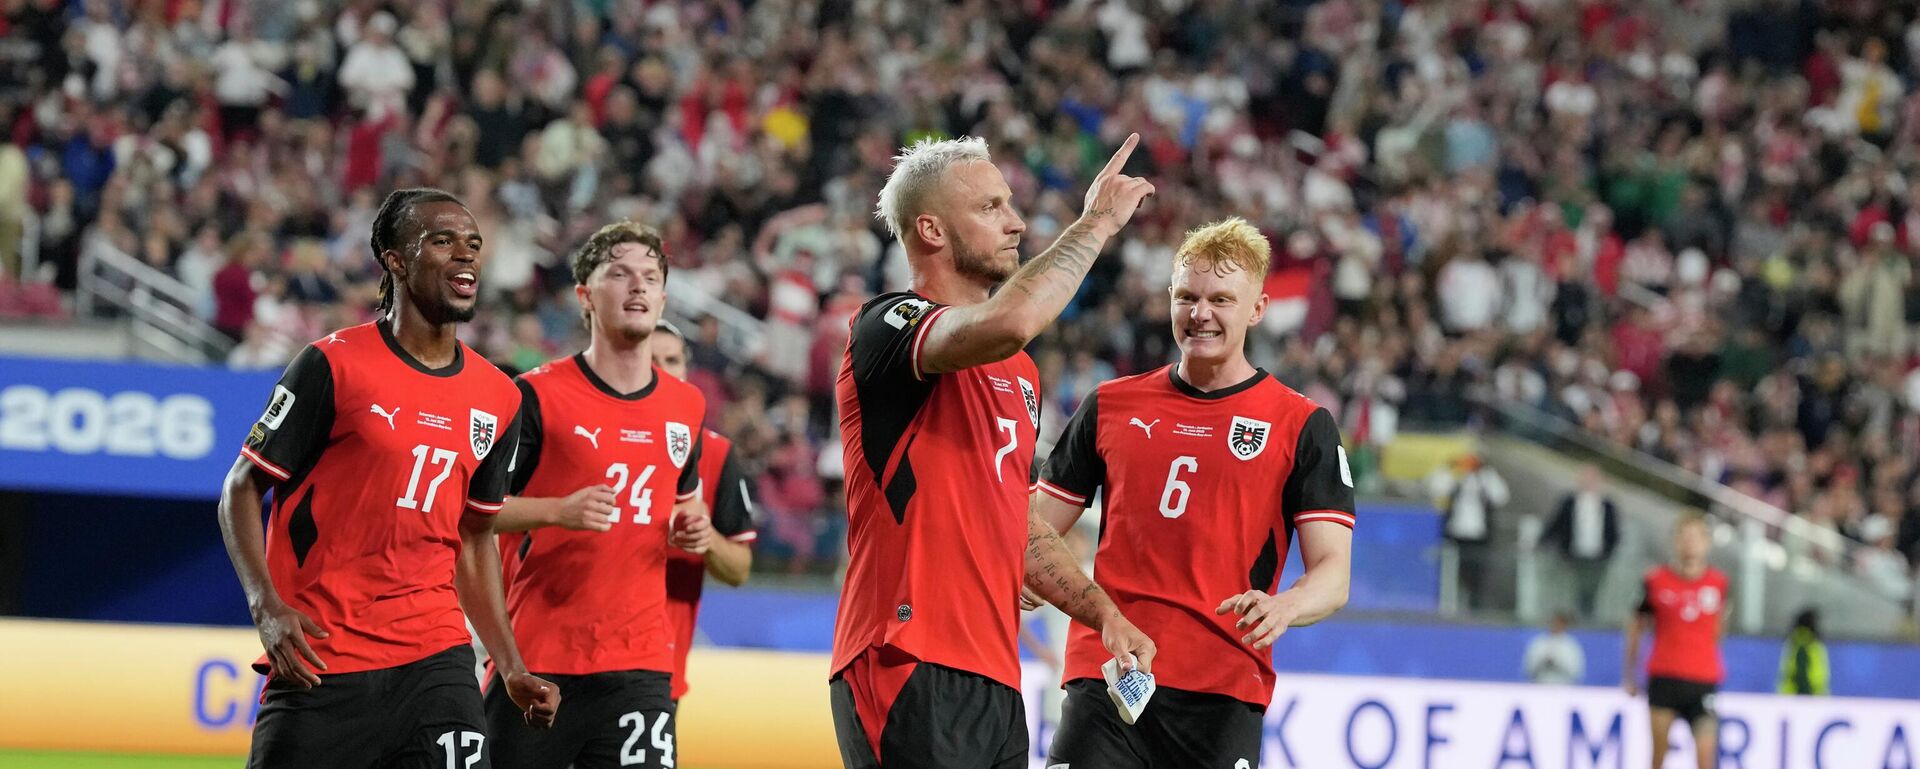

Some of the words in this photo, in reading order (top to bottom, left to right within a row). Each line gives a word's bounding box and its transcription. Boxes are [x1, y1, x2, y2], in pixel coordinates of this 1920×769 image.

[0, 384, 215, 460] 2026
[995, 416, 1018, 484] 7
[396, 444, 459, 513] 17
[605, 462, 656, 524] 24
[1159, 455, 1199, 519] 6
[1120, 671, 1143, 702] UNITES
[618, 710, 674, 769] 24
[1344, 699, 1456, 769] OF
[1494, 707, 1914, 769] AMRICA
